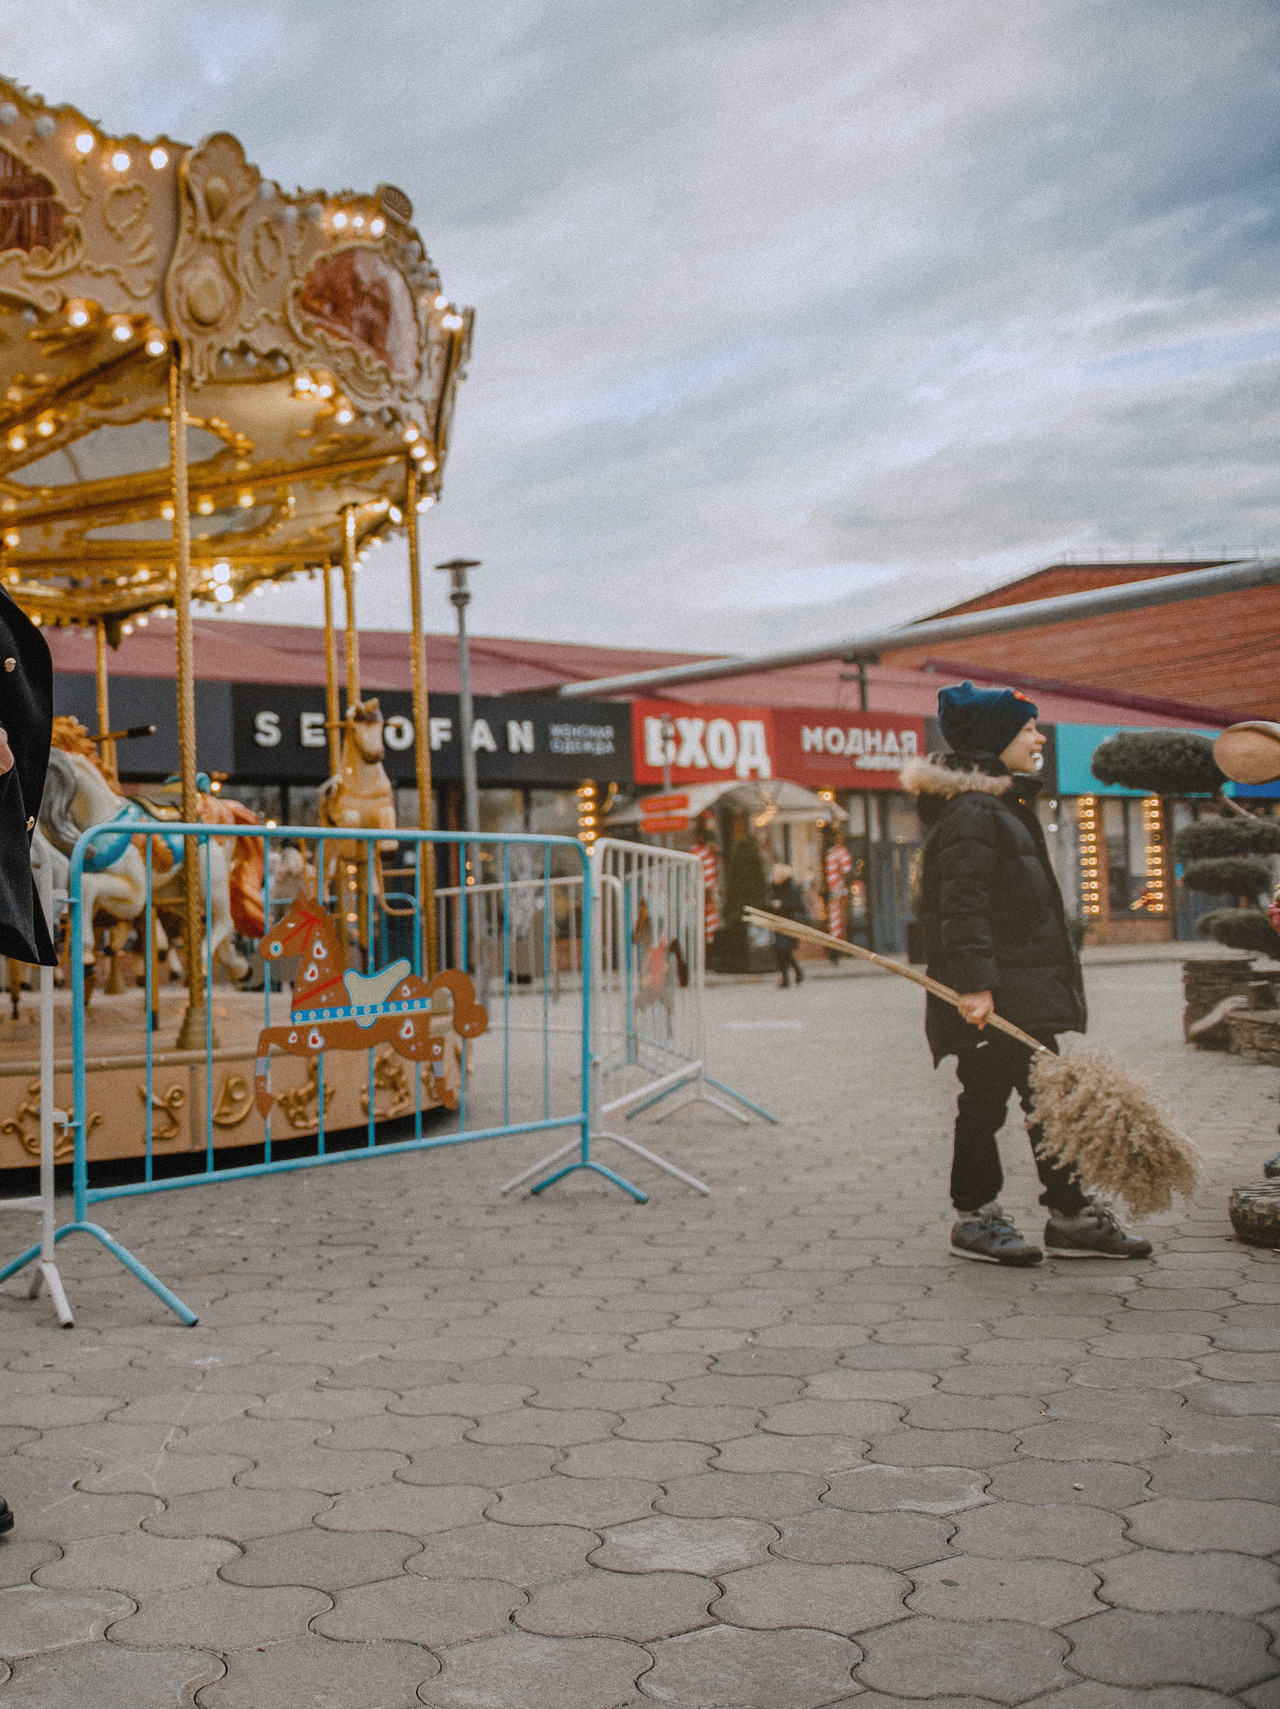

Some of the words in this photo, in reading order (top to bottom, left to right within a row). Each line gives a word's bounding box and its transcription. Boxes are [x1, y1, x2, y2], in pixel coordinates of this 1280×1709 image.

[254, 711, 535, 752] SEOFAN
[644, 716, 771, 779] ВХОД
[801, 726, 917, 756] МОДНАЯ
